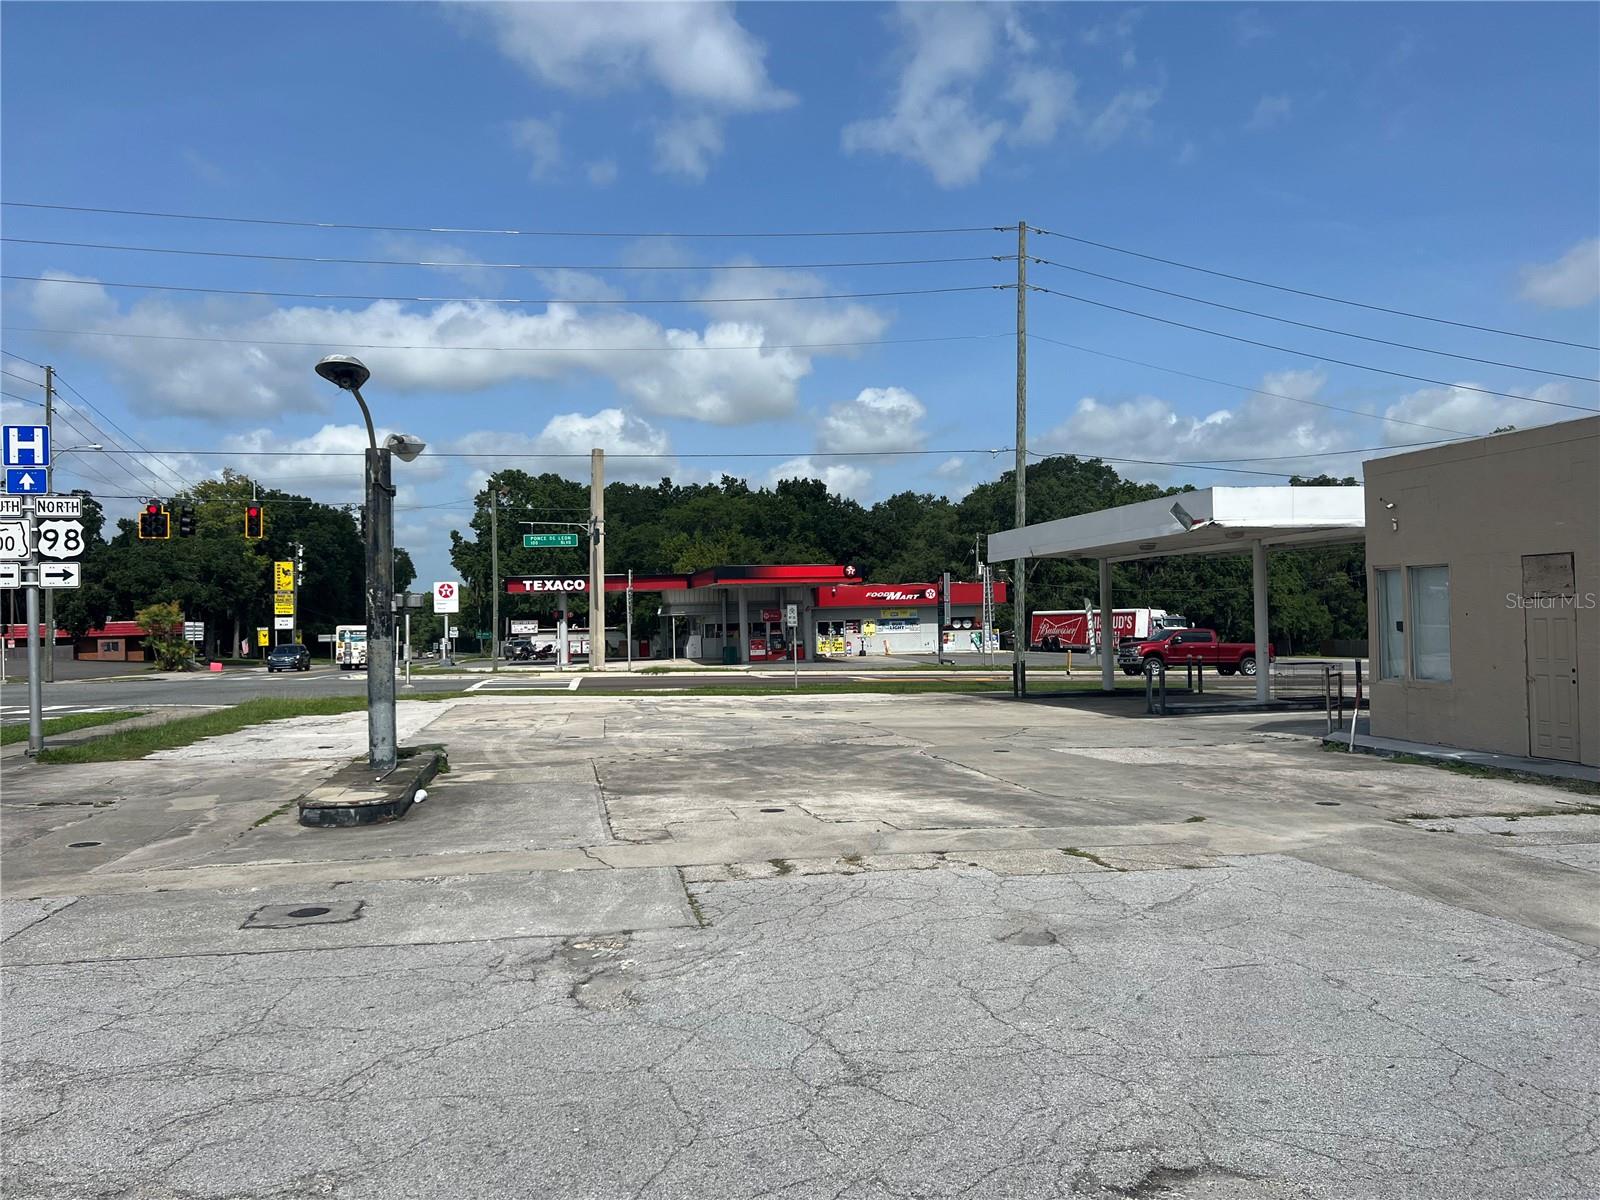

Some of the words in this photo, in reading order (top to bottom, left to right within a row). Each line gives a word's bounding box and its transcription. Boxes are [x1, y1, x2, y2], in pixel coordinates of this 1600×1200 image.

[8, 427, 44, 464] H
[38, 501, 80, 513] NORTH
[43, 528, 81, 551] 98
[522, 579, 586, 591] TEXACO
[1112, 615, 1133, 629] UD'S
[1038, 623, 1076, 636] Budweiser
